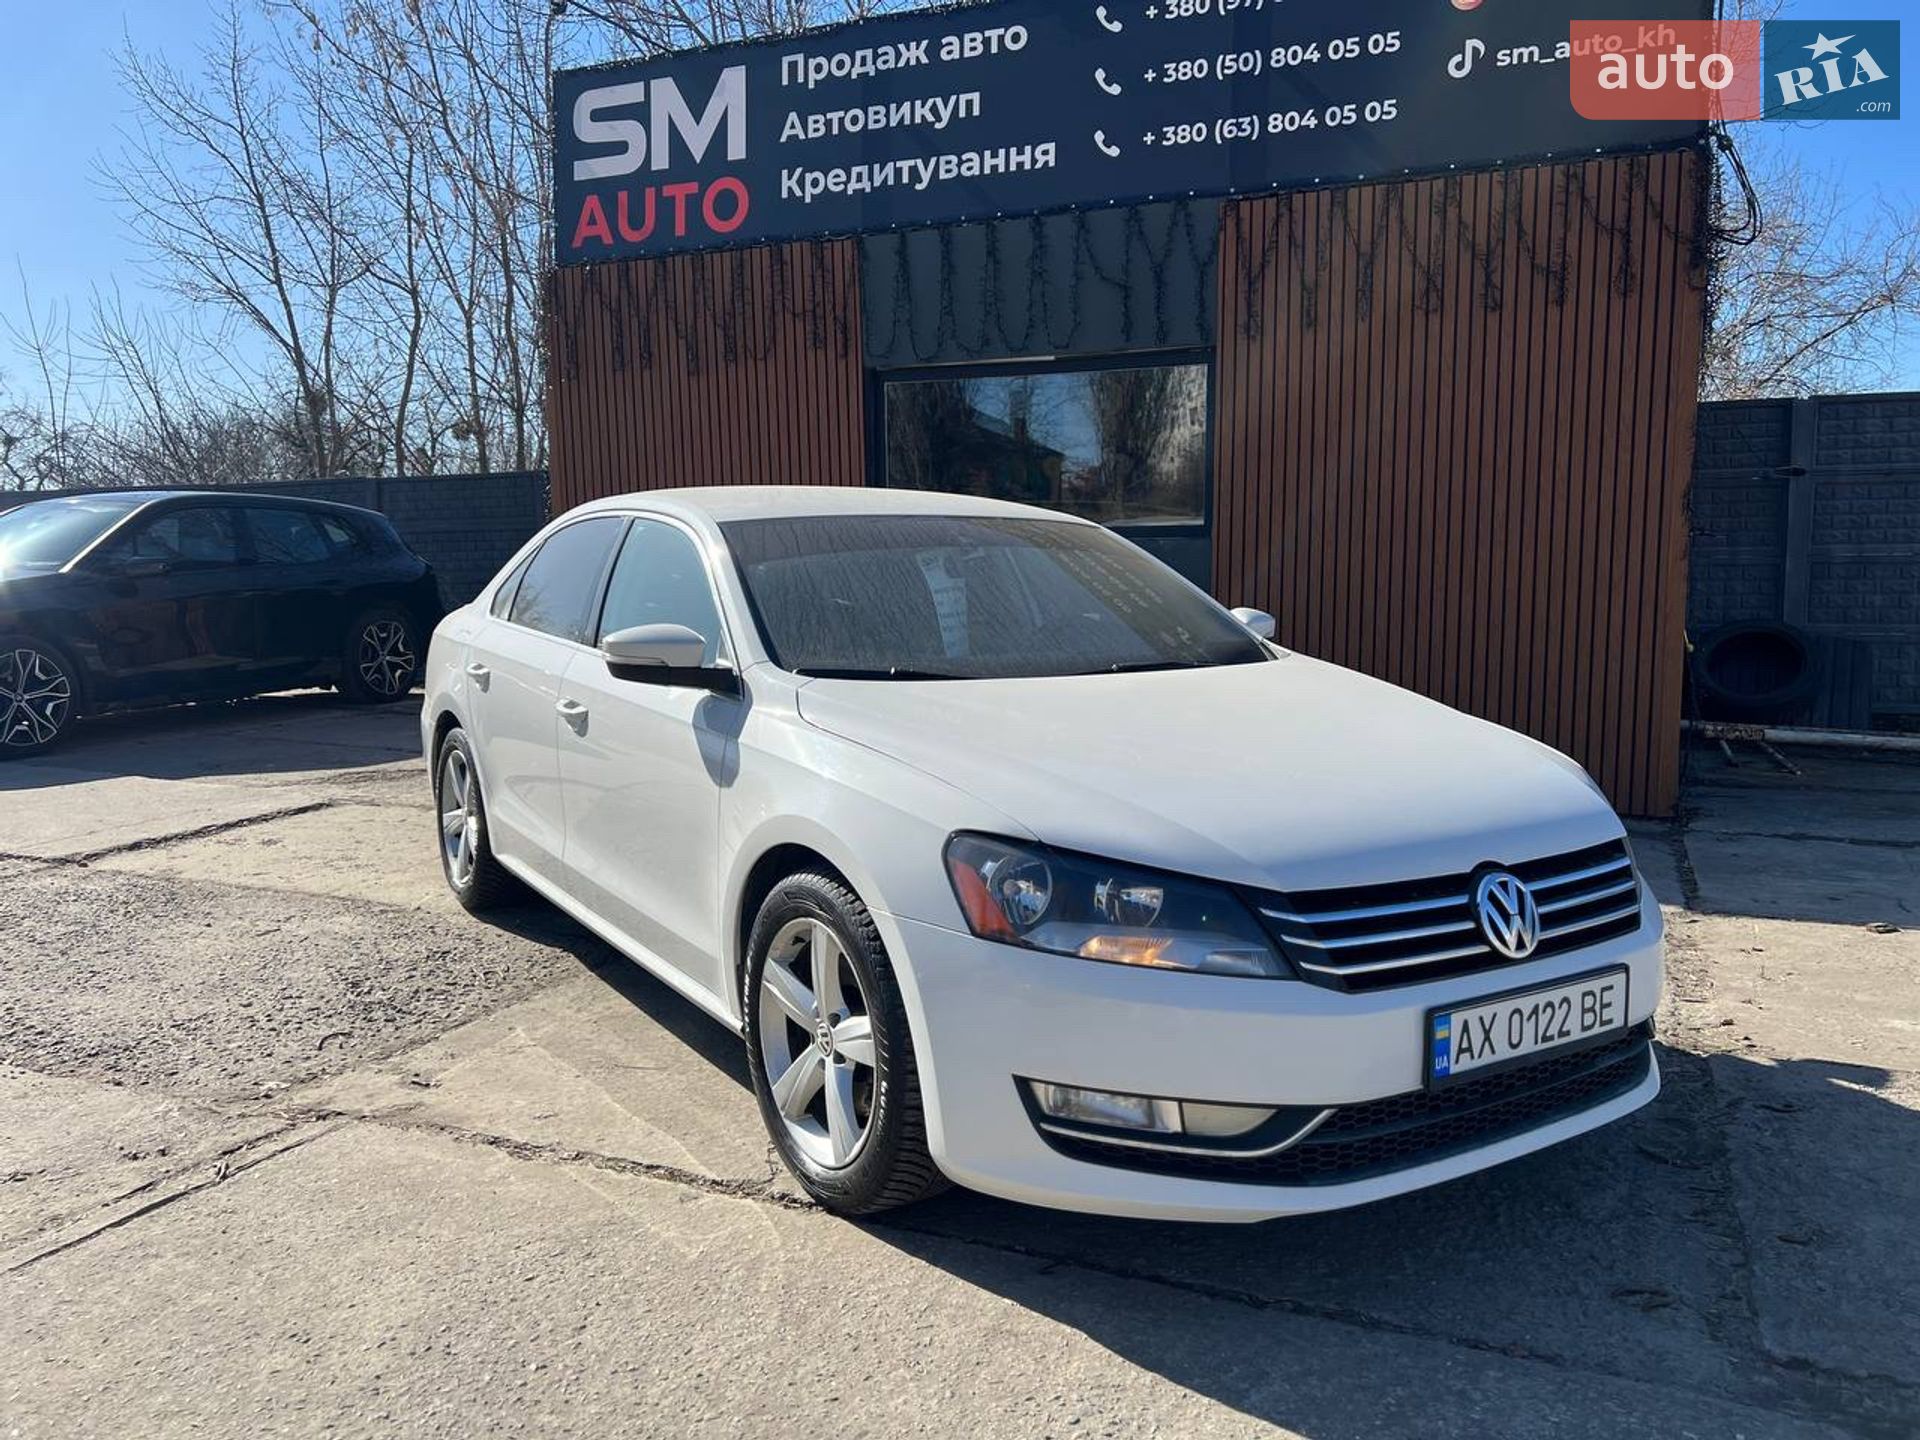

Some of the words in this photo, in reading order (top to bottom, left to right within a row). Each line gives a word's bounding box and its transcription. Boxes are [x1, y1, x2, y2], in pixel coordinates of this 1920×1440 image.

[1164, 0, 1210, 20] 380
[781, 37, 929, 89] Продаж
[939, 24, 1029, 59] авто
[1162, 58, 1209, 84] 380
[1215, 49, 1262, 81] (50)
[1269, 43, 1321, 68] 804
[1327, 37, 1361, 60] 05
[1367, 31, 1401, 55] 05
[572, 64, 748, 182] SM
[779, 91, 982, 143] Автовикуп
[1161, 122, 1208, 146] 380
[1214, 115, 1260, 144] (63)
[1267, 109, 1319, 133] 804
[1324, 104, 1358, 127] 05
[1364, 99, 1398, 122] 05
[780, 141, 1057, 203] Кредитування
[571, 175, 750, 249] AUTO
[1454, 1010, 1498, 1066] AX
[1508, 996, 1571, 1051] 0122
[1580, 984, 1614, 1034] BE
[1434, 1056, 1450, 1072] UA
